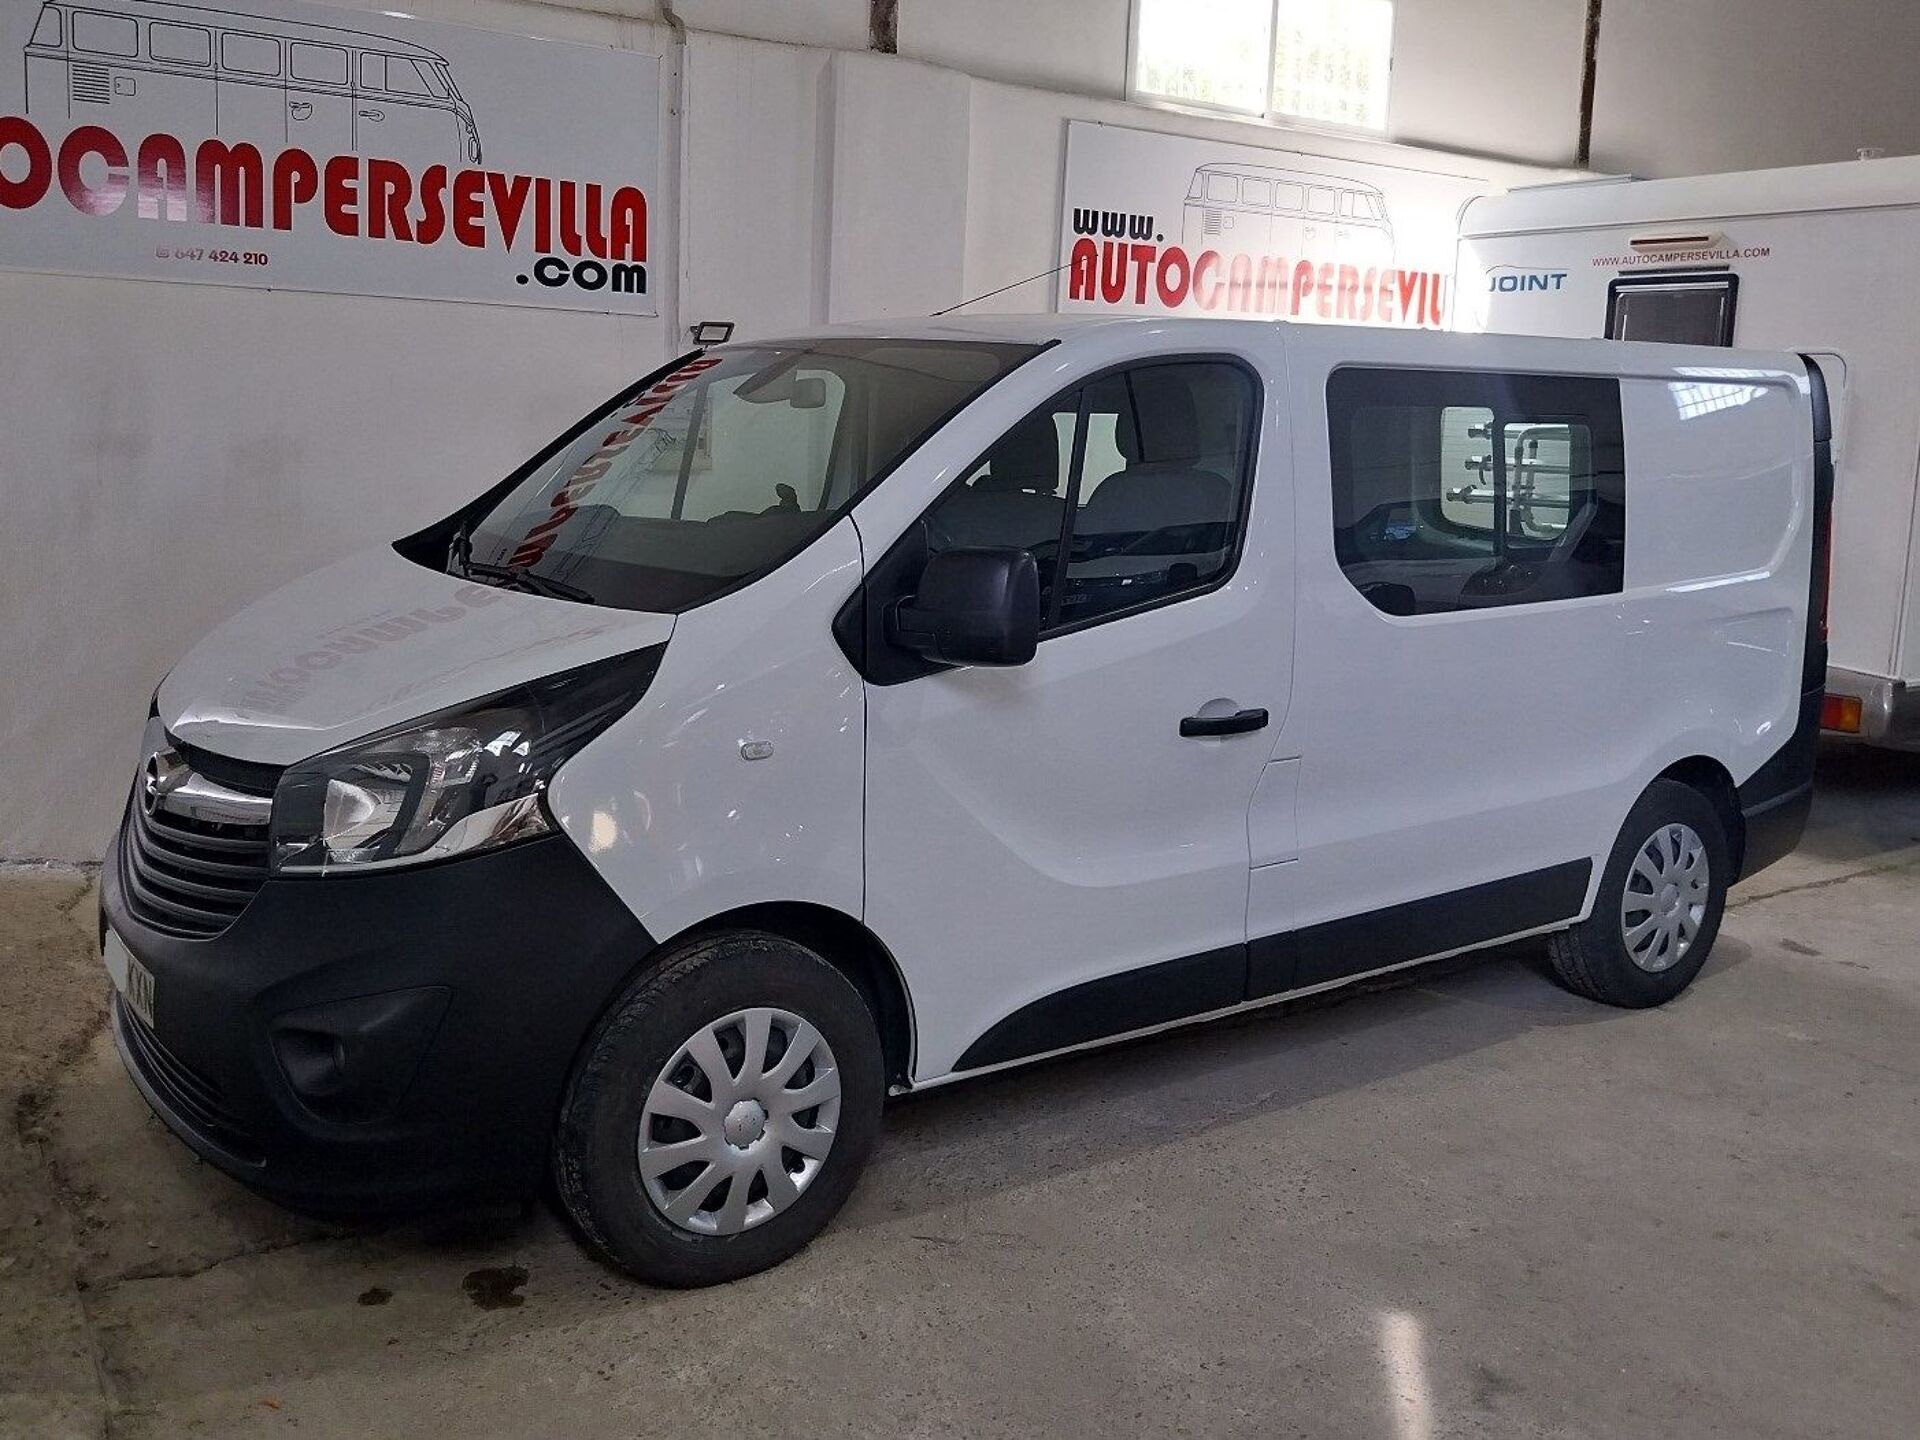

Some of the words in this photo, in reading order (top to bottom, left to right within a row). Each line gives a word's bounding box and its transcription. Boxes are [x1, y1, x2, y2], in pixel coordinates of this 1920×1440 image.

[1073, 208, 1164, 242] www.
[208, 250, 239, 263] 424
[243, 252, 268, 266] 210
[1592, 247, 1770, 267] WWW.AUTOCAMPERSEVILLA.COM
[1489, 273, 1568, 293] JOINT
